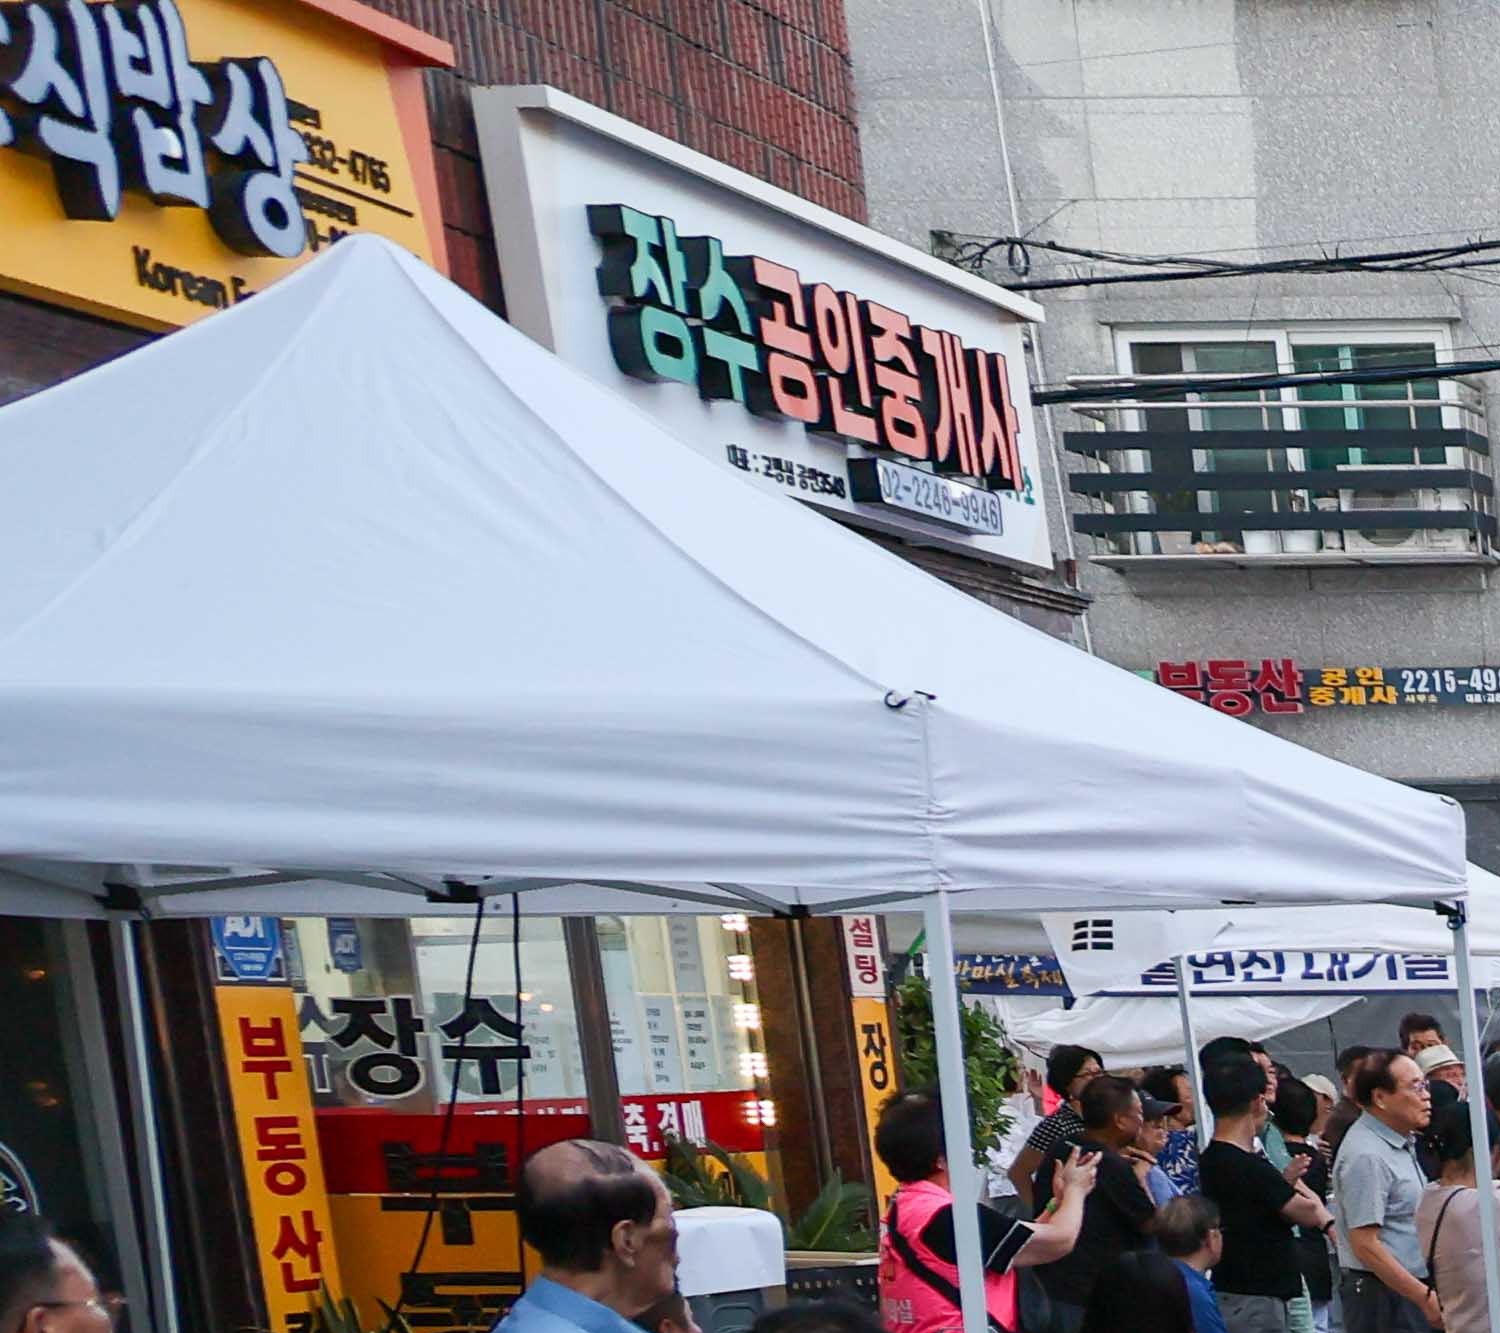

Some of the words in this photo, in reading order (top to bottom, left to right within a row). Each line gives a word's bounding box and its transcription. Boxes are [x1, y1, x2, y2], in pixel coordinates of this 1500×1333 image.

[0, 0, 309, 257] 식밥상
[132, 245, 229, 309] Korean
[881, 466, 999, 530] 02-2246-9946
[1319, 667, 1385, 687] 공인
